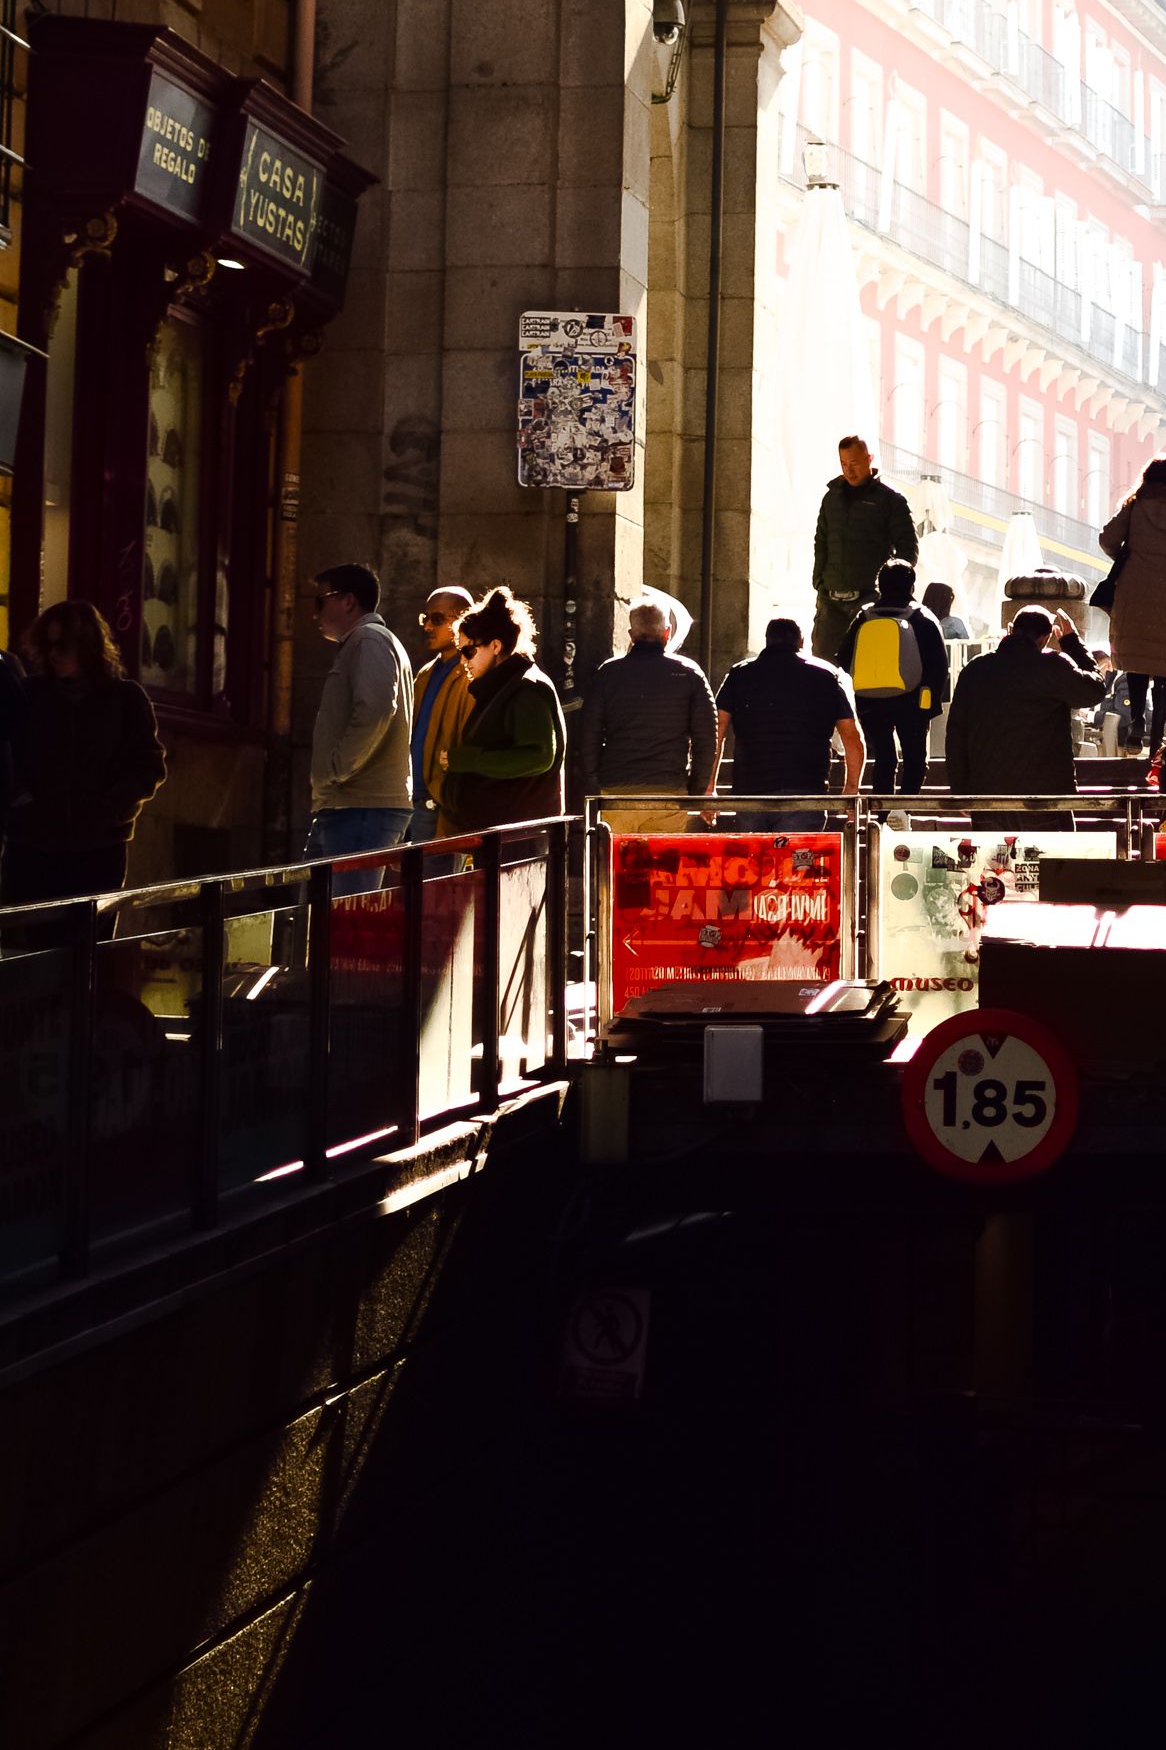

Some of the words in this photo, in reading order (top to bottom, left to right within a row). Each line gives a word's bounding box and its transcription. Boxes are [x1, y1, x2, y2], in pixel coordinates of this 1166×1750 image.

[146, 106, 194, 152] OBJETOS
[153, 142, 196, 184] REGALO
[259, 152, 305, 207] CASA
[249, 189, 305, 251] YUSTAS
[933, 1071, 1047, 1130] 1,85
